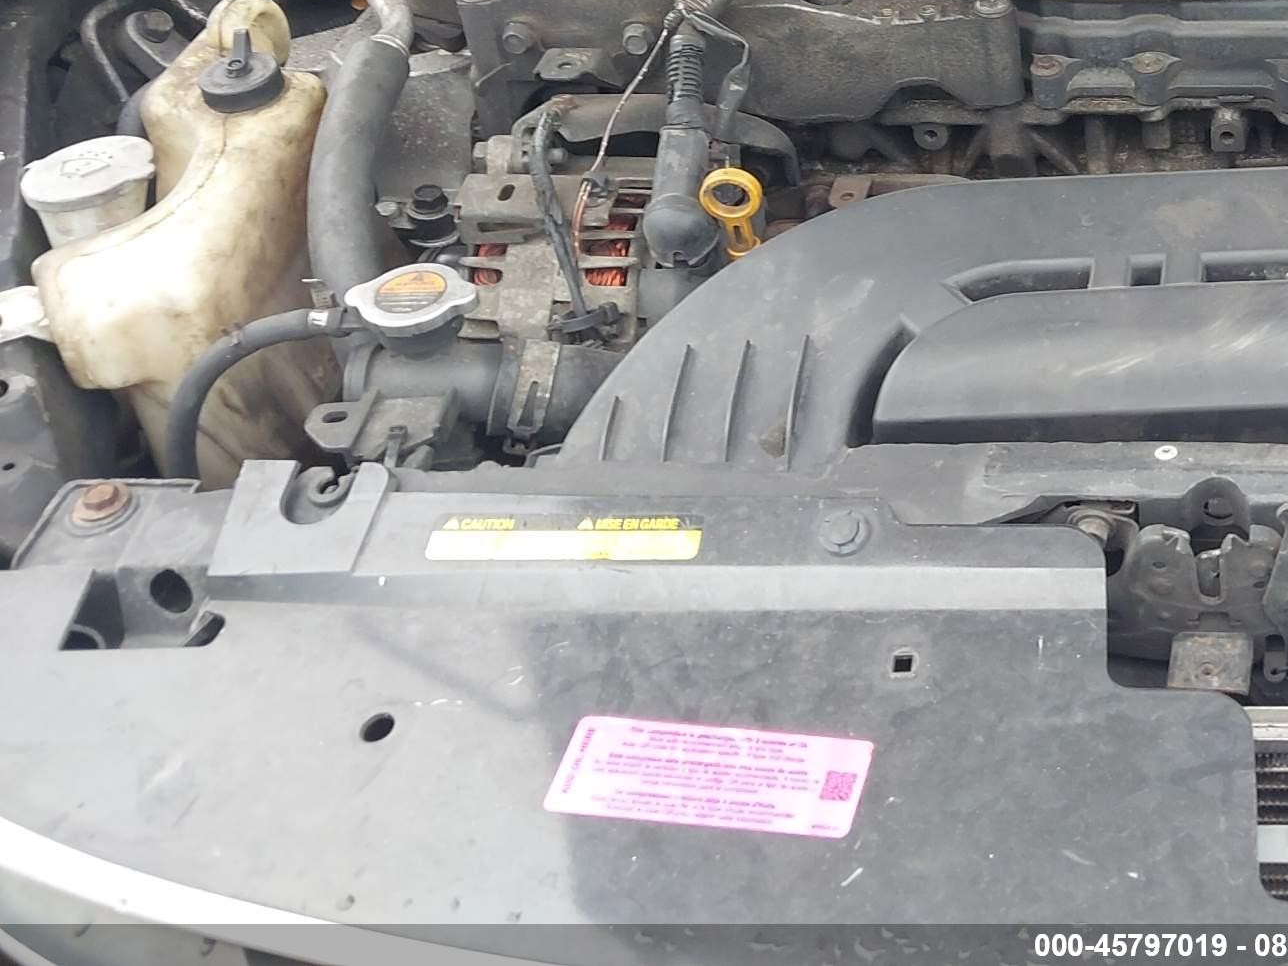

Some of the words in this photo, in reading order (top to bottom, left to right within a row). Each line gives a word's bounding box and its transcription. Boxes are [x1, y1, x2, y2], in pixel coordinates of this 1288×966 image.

[460, 519, 515, 531] CAUTION
[595, 519, 622, 531] MISE
[622, 519, 640, 531] EN
[640, 519, 680, 531] GARDE
